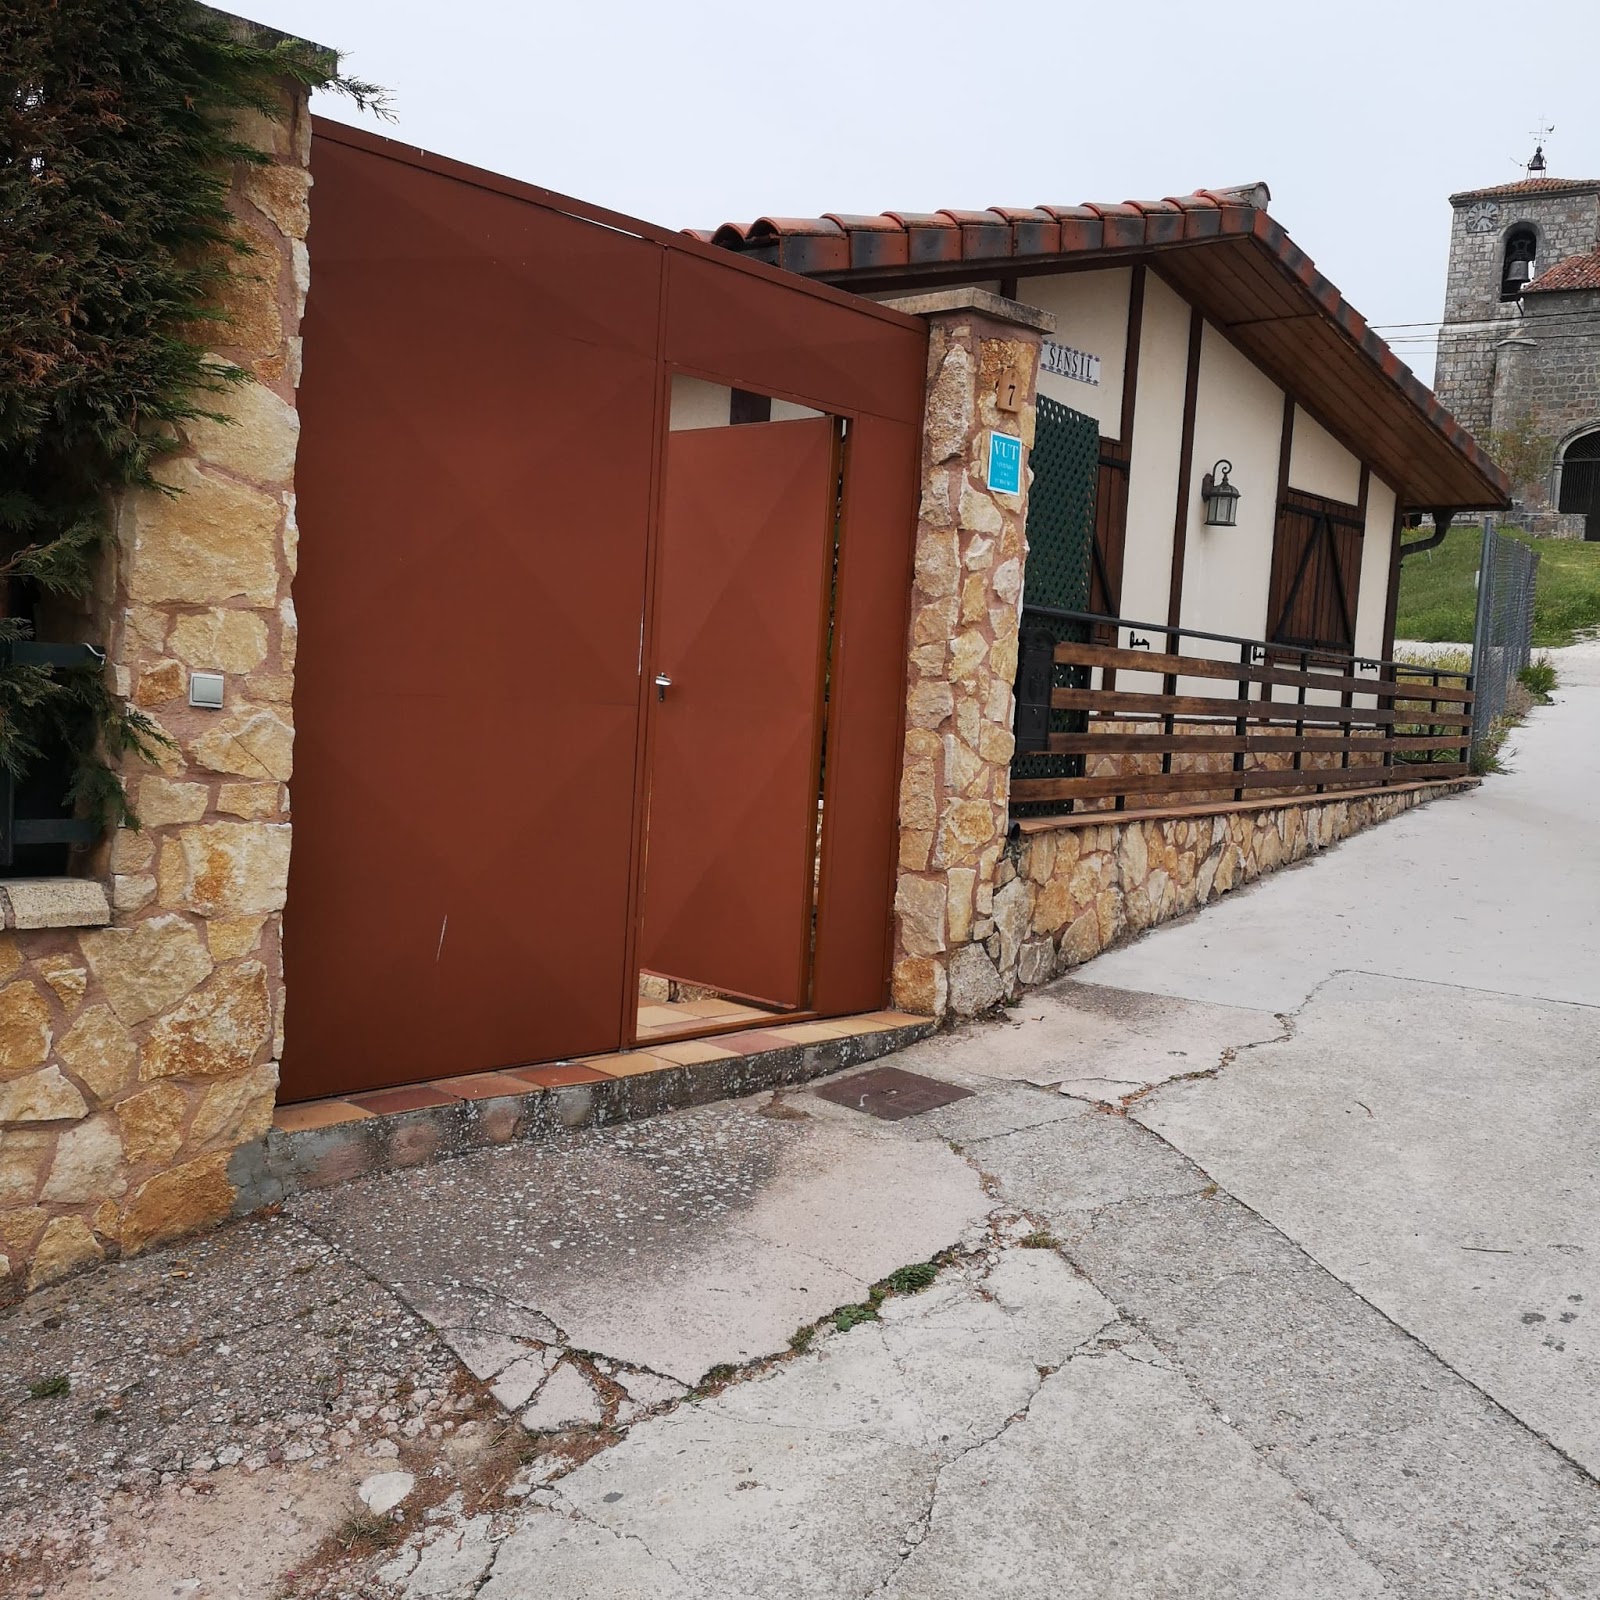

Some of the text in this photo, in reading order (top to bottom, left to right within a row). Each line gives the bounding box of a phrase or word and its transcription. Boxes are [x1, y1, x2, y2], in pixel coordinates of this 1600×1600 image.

[1050, 346, 1092, 379] SANSIL
[1008, 384, 1016, 406] 7
[994, 440, 1019, 460] VUT
